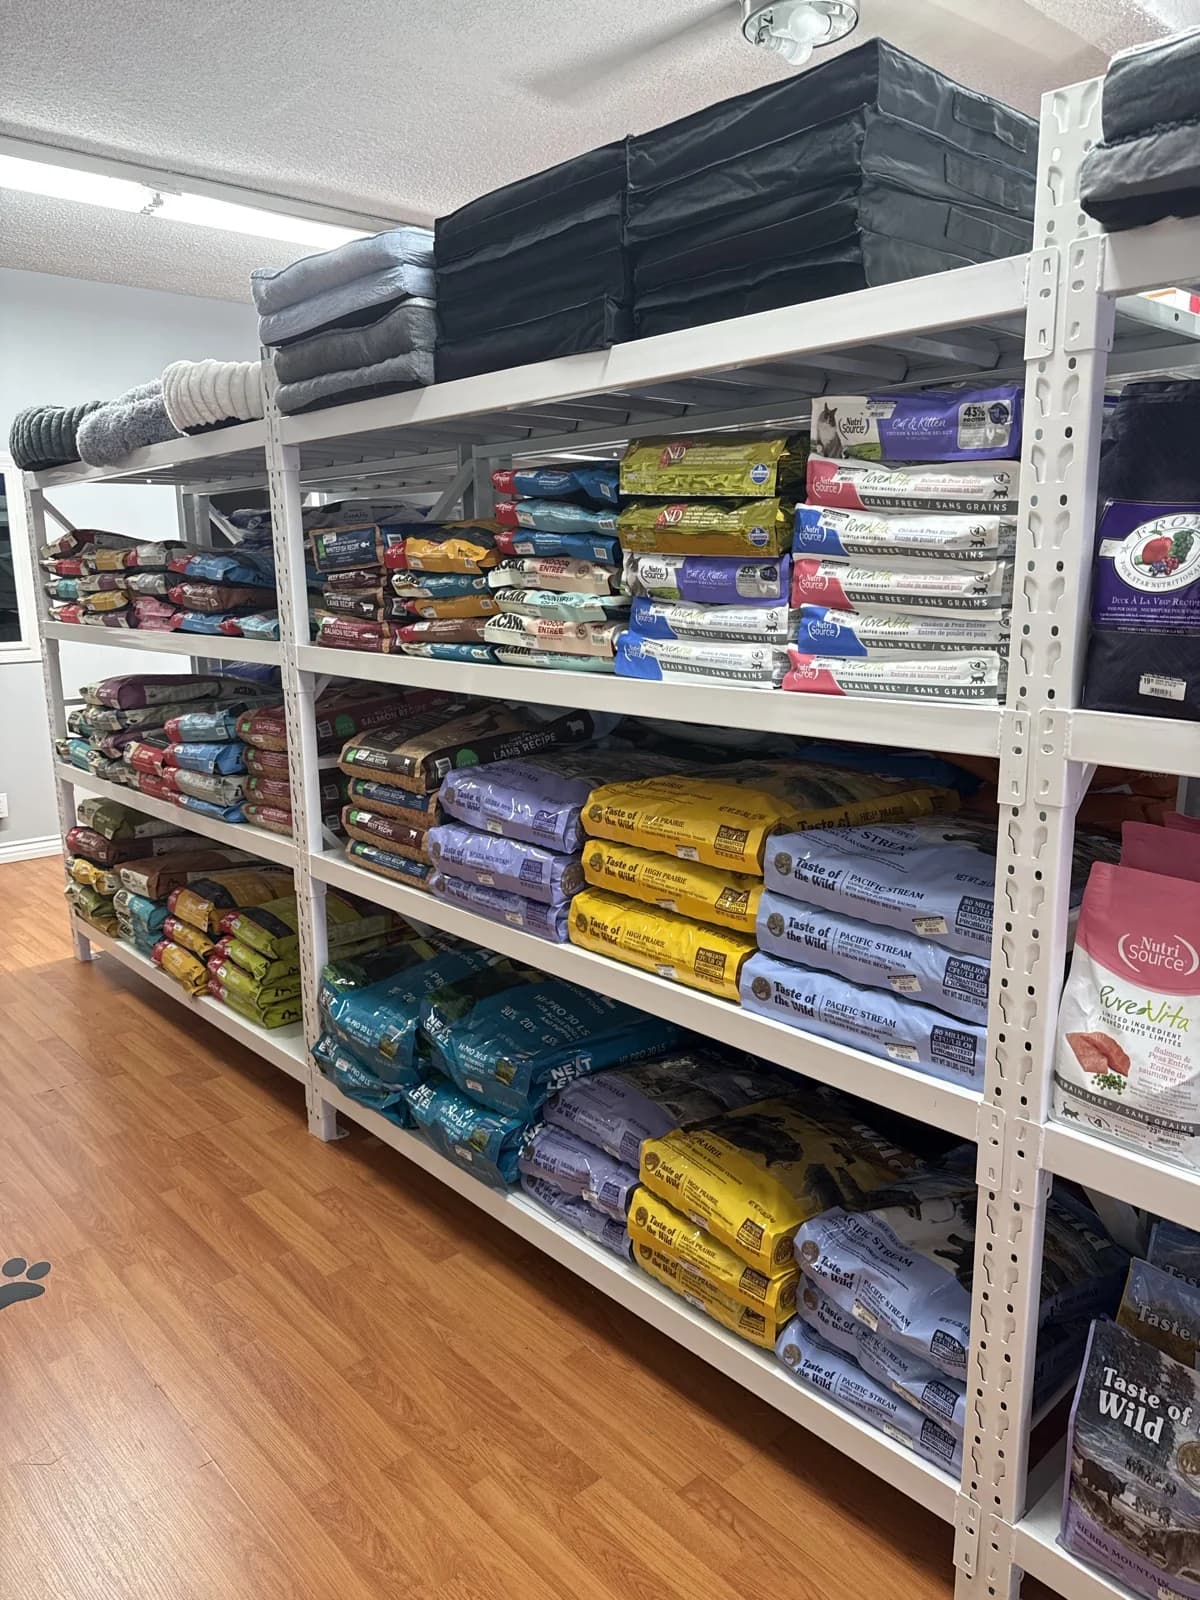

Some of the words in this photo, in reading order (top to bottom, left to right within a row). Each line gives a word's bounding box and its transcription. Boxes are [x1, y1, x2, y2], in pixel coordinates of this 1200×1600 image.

[846, 416, 862, 427] Nutri
[964, 406, 985, 418] 43%
[842, 424, 865, 434] Source
[892, 418, 906, 430] Cat
[918, 417, 946, 430] Kitten
[816, 483, 838, 493] Source
[864, 497, 891, 506] GRAIN
[936, 501, 961, 510] SANS
[967, 502, 1008, 512] GRAINS
[848, 546, 873, 554] GRAIN
[915, 549, 939, 558] SANS
[944, 551, 984, 559] GRAINS
[645, 571, 665, 580] Source
[648, 565, 663, 574] Nutri
[806, 574, 821, 583] Nutri
[802, 581, 823, 590] Source
[849, 593, 875, 602] GRAIN
[918, 596, 942, 605] SANS
[948, 598, 988, 607] GRAINS
[324, 627, 342, 636] SALMON
[342, 630, 359, 638] RECIPE
[811, 627, 835, 637] Source
[816, 621, 831, 630] Nutri
[749, 634, 777, 643] GRAINS
[866, 640, 894, 649] GRAIN
[940, 643, 966, 652] SANS
[711, 669, 730, 678] SANS
[734, 671, 763, 680] GRAINS
[842, 682, 870, 691] GRAIN
[915, 686, 939, 695] SANS
[945, 687, 985, 696] GRAINS
[361, 710, 397, 727] SALMON
[399, 703, 427, 718] RECIPE
[493, 746, 521, 761] LAMB
[523, 733, 557, 752] RECIPE
[604, 816, 617, 826] the
[617, 820, 634, 830] Wild
[605, 807, 627, 818] Taste
[628, 811, 639, 821] of
[661, 816, 686, 828] PRAIRIE
[606, 856, 627, 869] Taste
[628, 863, 639, 873] of
[796, 858, 825, 876] Taste
[828, 869, 842, 880] of
[604, 867, 617, 877] the
[617, 871, 636, 883] Wild
[644, 866, 662, 878] HIGH
[663, 872, 687, 885] PRAIRIE
[794, 869, 810, 881] the
[812, 874, 837, 891] Wild
[850, 874, 886, 893] PACIFIC
[887, 886, 925, 900] STREAM
[589, 916, 609, 932] Taste
[610, 926, 621, 936] of
[788, 917, 815, 934] Taste
[818, 927, 831, 938] of
[589, 927, 601, 938] the
[602, 933, 618, 946] Wild
[626, 930, 643, 941] HIGH
[643, 935, 665, 948] PRAIRIE
[786, 930, 802, 943] the
[803, 935, 828, 951] Wild
[839, 931, 873, 948] PACIFIC
[875, 942, 913, 960] STREAM
[1140, 936, 1180, 958] Nutri
[1128, 944, 1184, 971] Source
[947, 966, 976, 979] CFU/LB
[960, 962, 988, 976] MILLION
[774, 981, 801, 999] Taste
[805, 994, 817, 1006] of
[774, 994, 790, 1008] the
[791, 1001, 815, 1017] Wild
[825, 999, 859, 1016] PACIFIC
[860, 1010, 897, 1028] STREAM
[1102, 1010, 1128, 1024] LIMITED
[1131, 1020, 1182, 1040] INGREDIENT
[944, 1029, 974, 1043] MILLION
[1149, 1030, 1182, 1048] LIMITÉS
[1148, 1051, 1166, 1063] Peas
[1167, 1056, 1193, 1071] Entrée
[1154, 1046, 1182, 1062] Salmon
[1150, 1063, 1174, 1076] Entrée
[1176, 1071, 1186, 1079] de
[1125, 1108, 1150, 1122] SANS
[1154, 1118, 1194, 1133] GRAINS
[654, 1169, 665, 1180] the
[666, 1175, 680, 1190] Wild
[660, 1161, 674, 1175] Taste
[675, 1172, 684, 1181] of
[687, 1178, 700, 1191] HIGH
[700, 1187, 719, 1206] PRAIRIE
[646, 1223, 657, 1235] the
[658, 1230, 673, 1246] Wild
[649, 1214, 667, 1232] Taste
[667, 1227, 677, 1236] of
[695, 1241, 717, 1259] PRAIRIE
[872, 1235, 915, 1268] STREAM
[652, 1257, 662, 1268] the
[662, 1263, 677, 1280] Wild
[820, 1256, 841, 1275] Taste
[844, 1271, 855, 1282] of
[830, 1273, 853, 1290] Wild
[864, 1279, 886, 1304] PACIFIC
[885, 1300, 912, 1328] STREAM
[817, 1311, 830, 1325] the
[820, 1301, 843, 1323] Taste
[844, 1320, 855, 1331] of
[1136, 1302, 1191, 1341] Taste
[881, 1345, 909, 1373] STREAM
[796, 1367, 810, 1378] the
[812, 1374, 833, 1391] Wild
[803, 1359, 823, 1374] Taste
[824, 1370, 836, 1380] of
[841, 1377, 868, 1396] PACIFIC
[868, 1392, 898, 1412] STREAM
[1103, 1367, 1160, 1409] Taste
[1168, 1404, 1193, 1427] of
[1099, 1389, 1164, 1444] Wild
[1077, 1521, 1109, 1553] SIERRA
